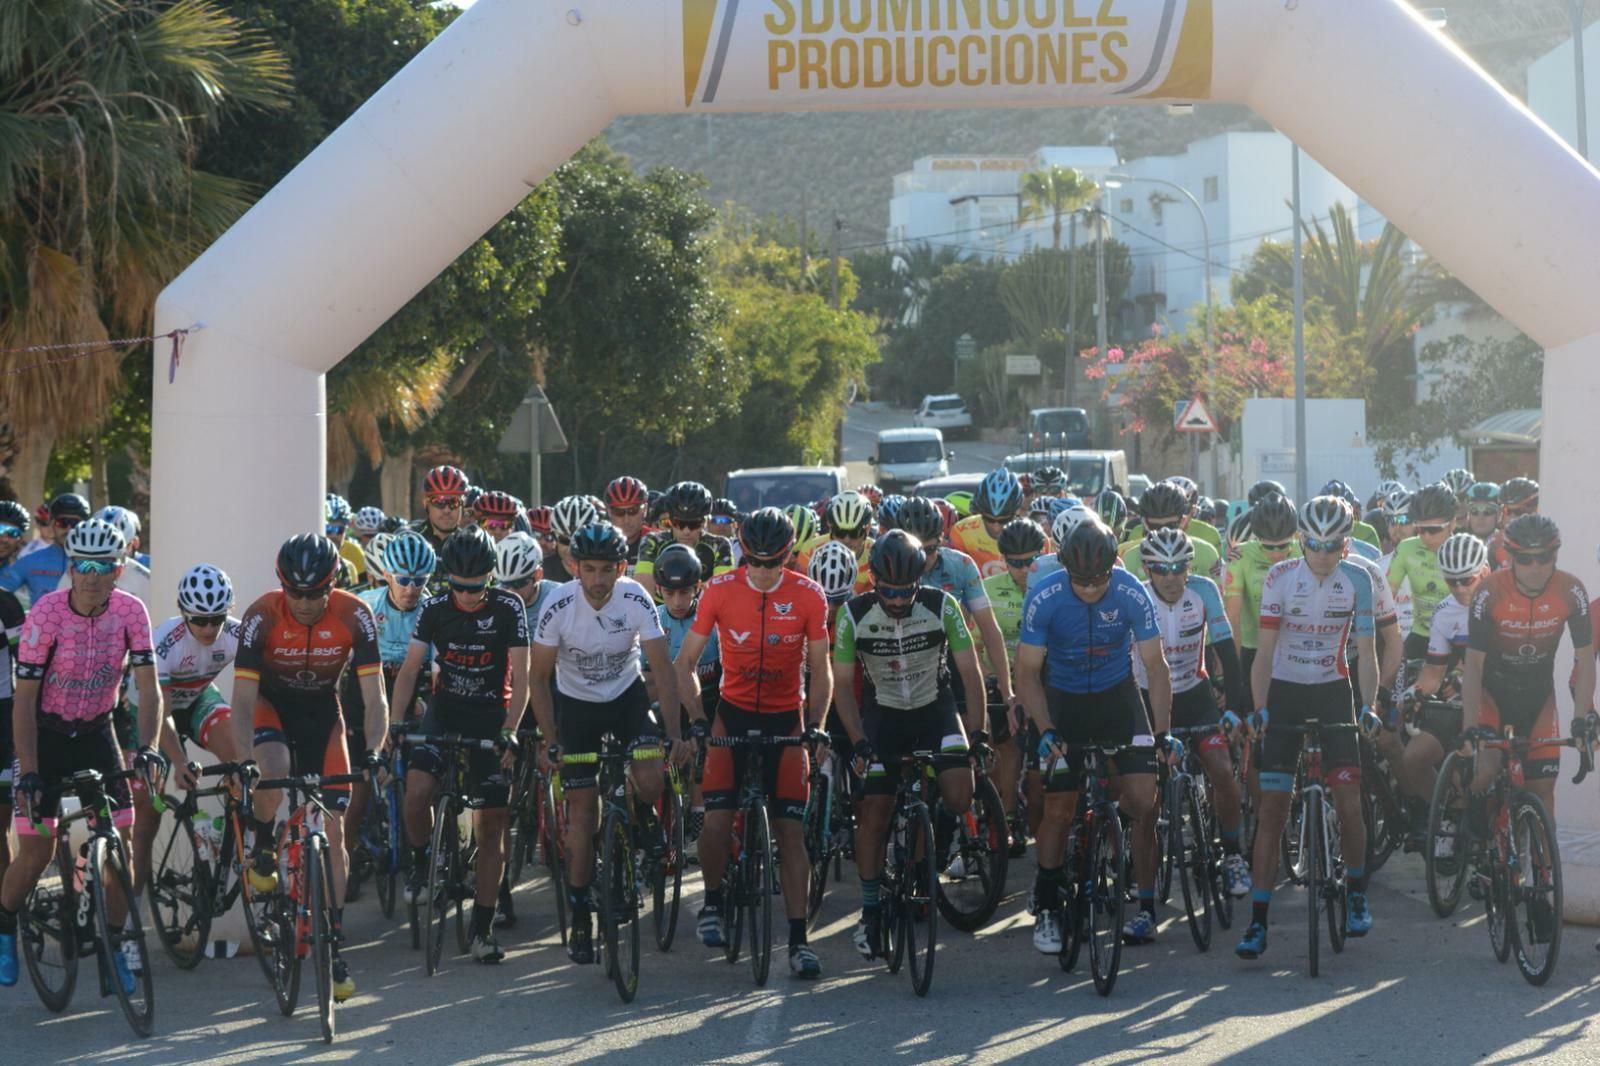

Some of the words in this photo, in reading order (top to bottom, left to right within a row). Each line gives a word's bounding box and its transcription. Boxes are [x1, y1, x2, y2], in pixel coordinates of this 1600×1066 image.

[768, 31, 1128, 91] PRODUCCIONES
[1026, 583, 1063, 632] FASTER
[1116, 583, 1153, 630] FASTER
